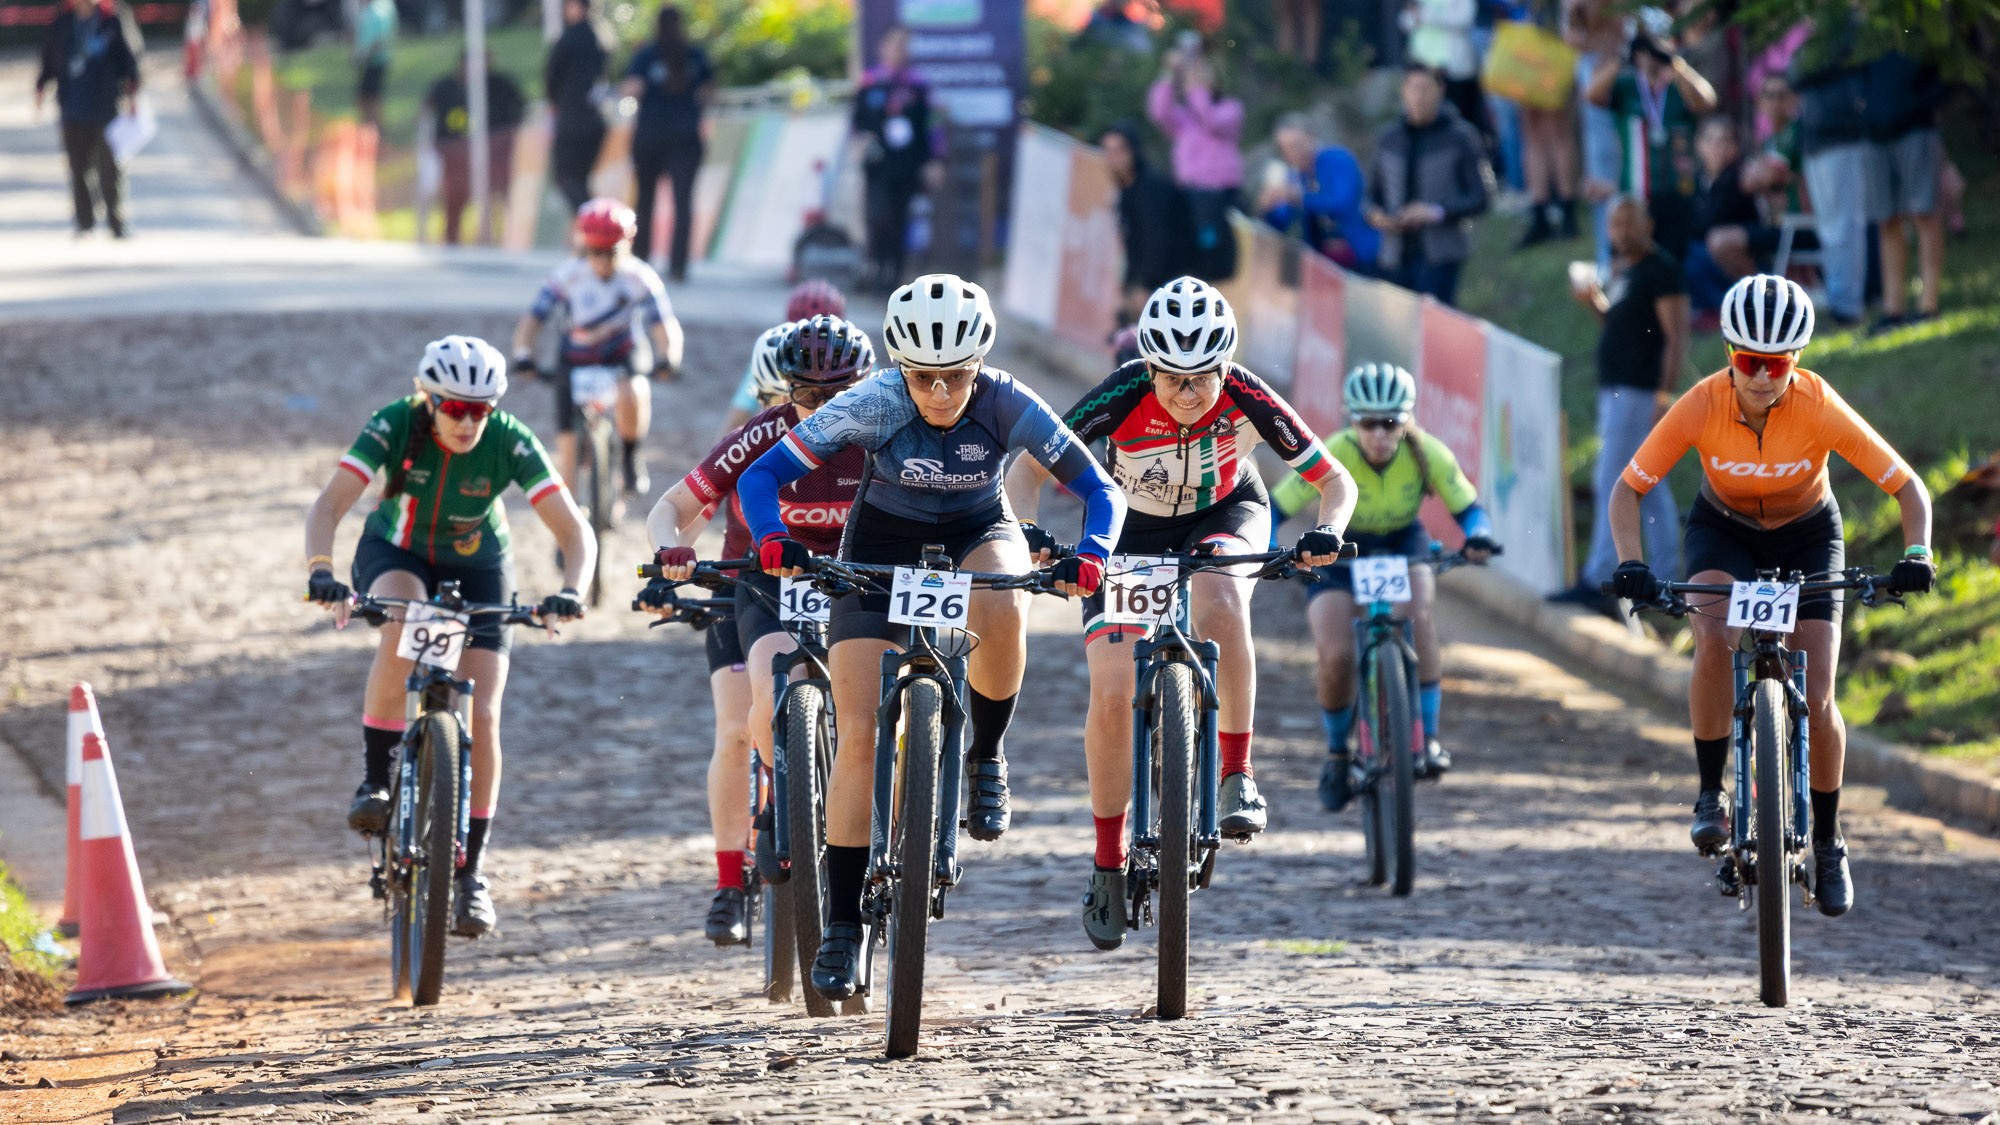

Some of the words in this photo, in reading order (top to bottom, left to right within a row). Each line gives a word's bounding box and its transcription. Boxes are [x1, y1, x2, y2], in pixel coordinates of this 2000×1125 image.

[715, 417, 790, 474] TOYOTA
[900, 468, 988, 484] Cyclesport
[1711, 456, 1812, 478] VOLTA
[837, 477, 861, 486] SUDA
[787, 508, 850, 524] CON
[1361, 576, 1406, 595] 129
[896, 591, 964, 619] 126
[1111, 583, 1172, 615] 169
[1737, 599, 1791, 624] 101
[411, 628, 450, 657] 99
